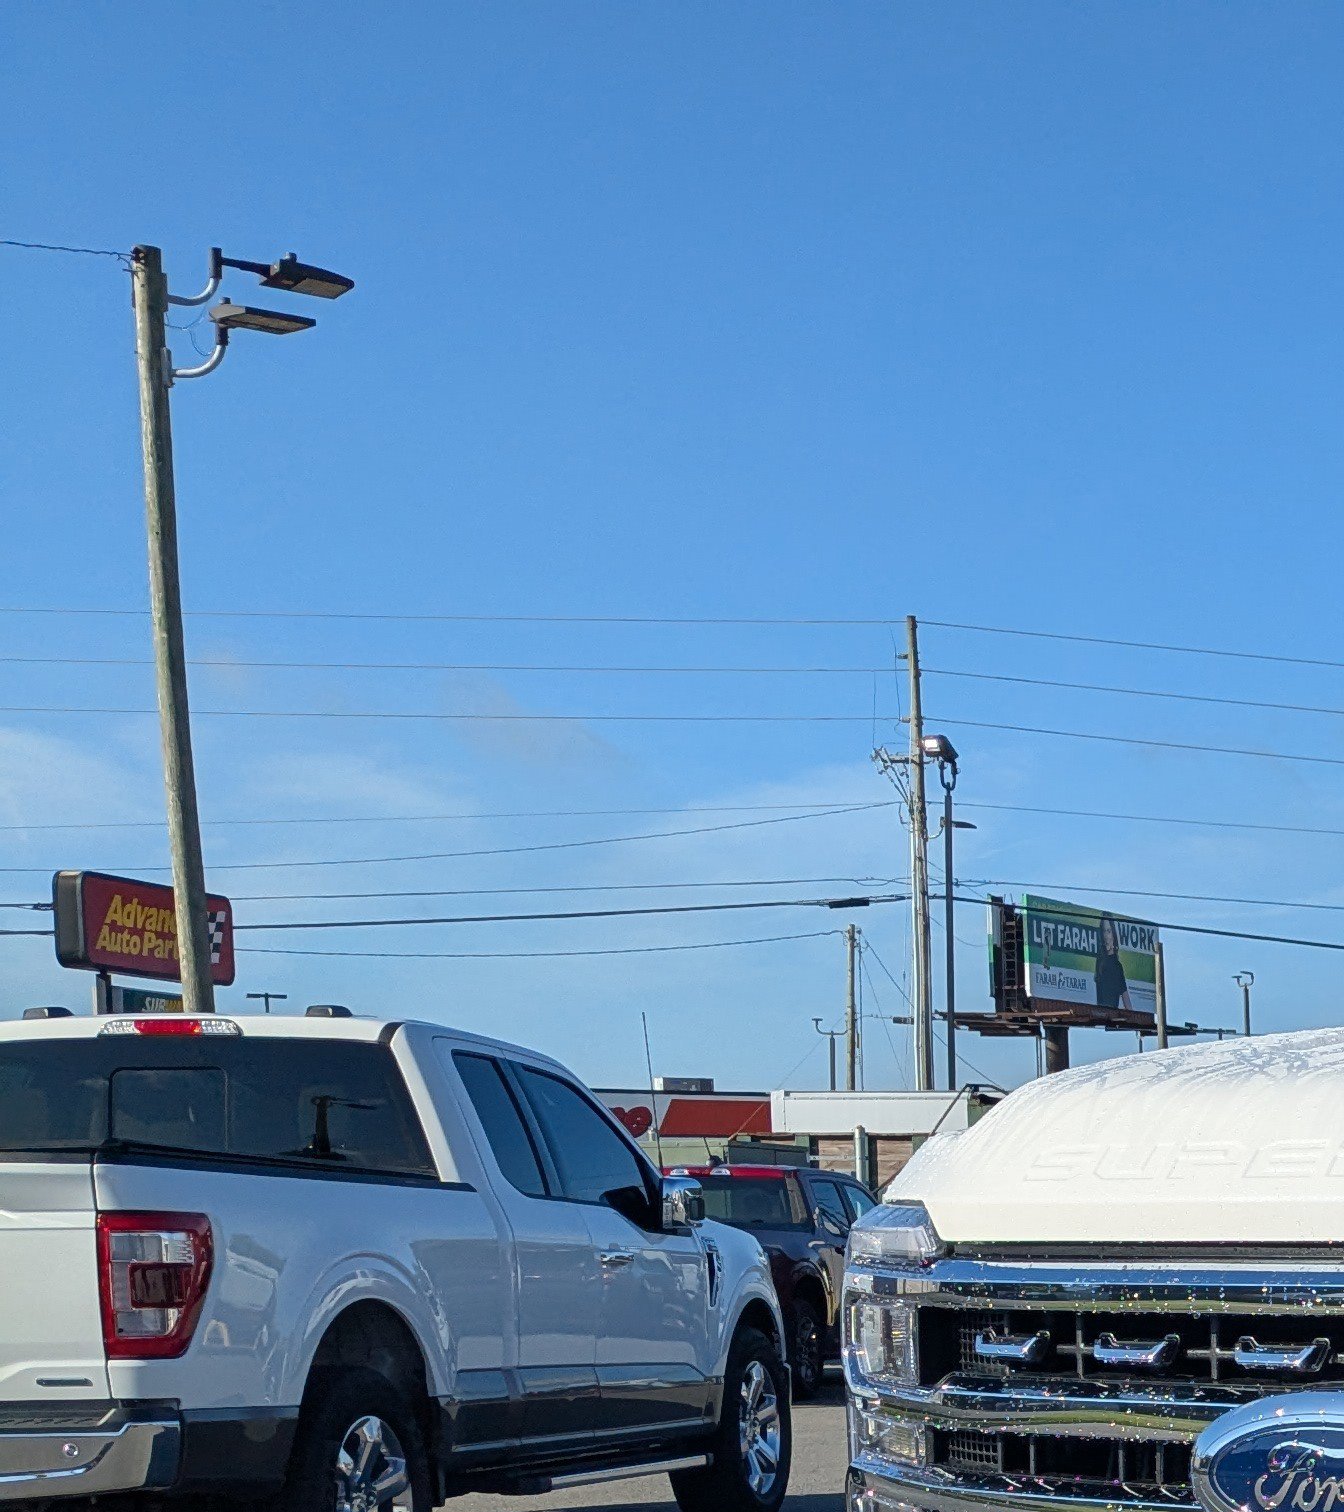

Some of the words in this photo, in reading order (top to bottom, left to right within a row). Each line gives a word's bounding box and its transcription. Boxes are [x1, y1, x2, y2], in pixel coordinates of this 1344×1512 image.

[96, 924, 140, 955] Auto
[142, 931, 180, 960] Part
[1058, 924, 1098, 953] FARAH
[1117, 920, 1156, 952] WORK
